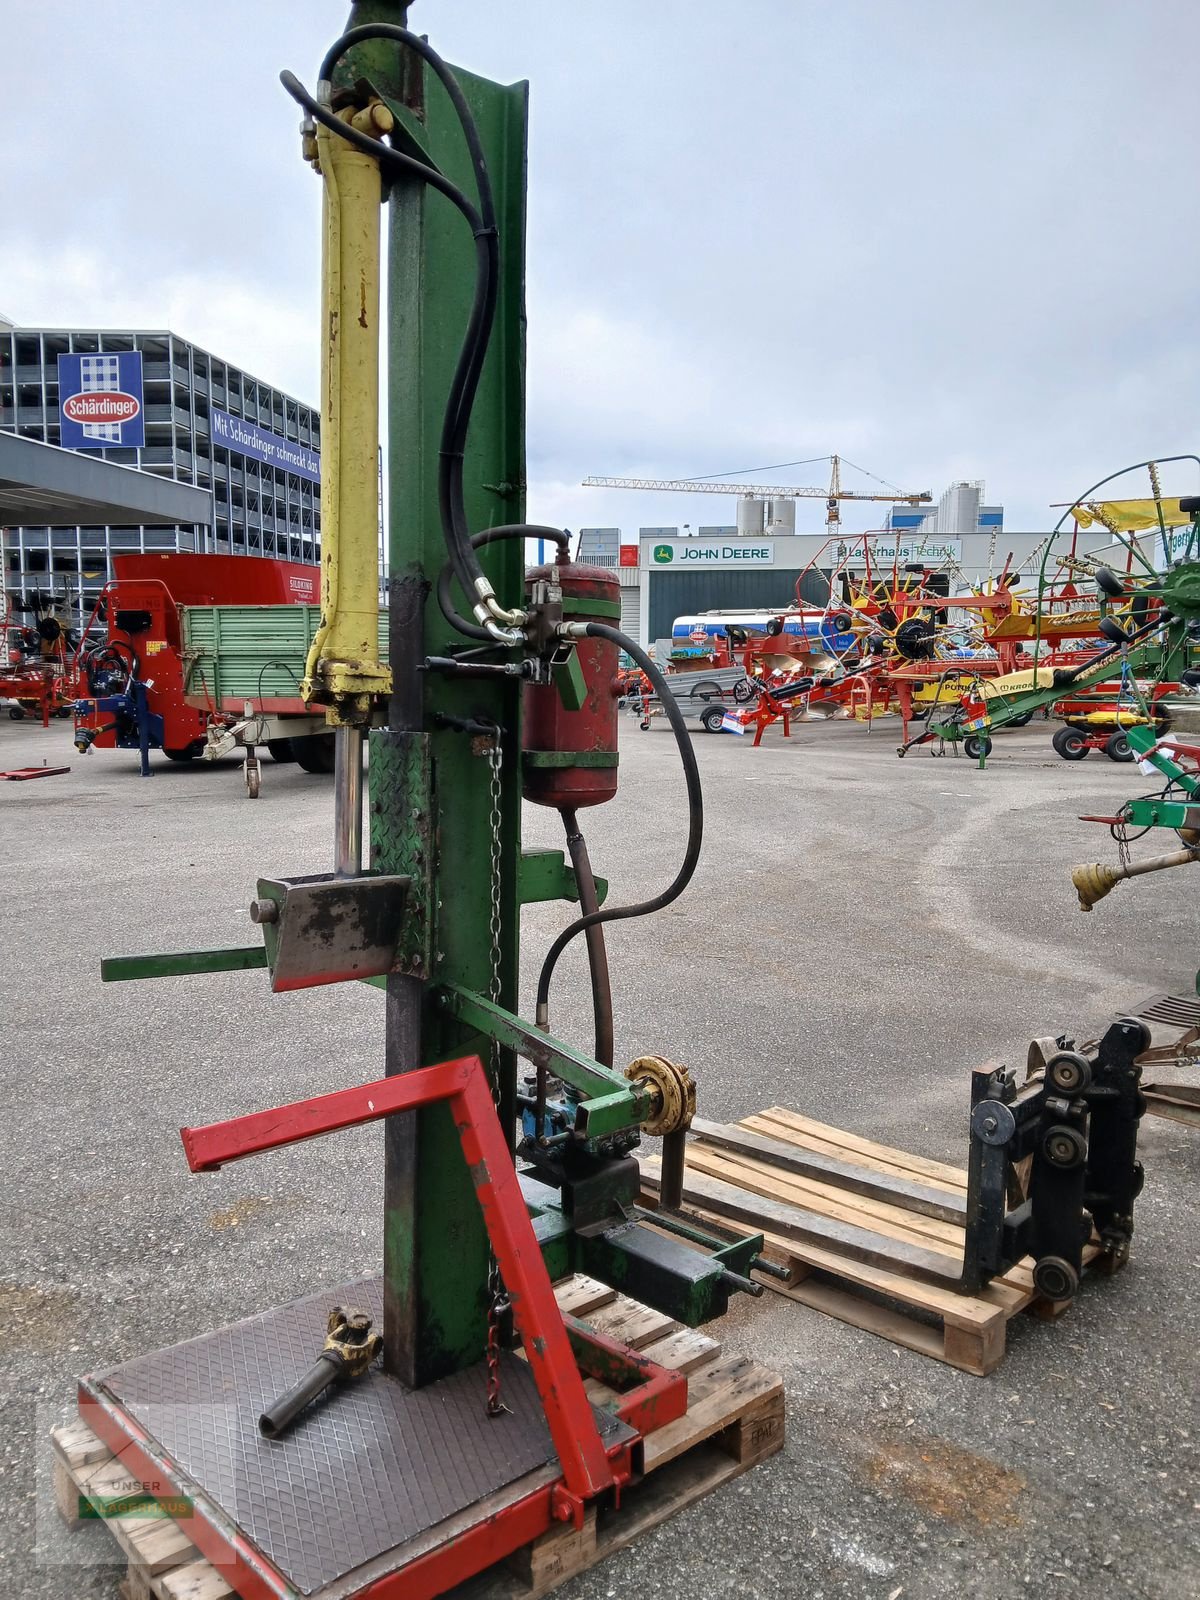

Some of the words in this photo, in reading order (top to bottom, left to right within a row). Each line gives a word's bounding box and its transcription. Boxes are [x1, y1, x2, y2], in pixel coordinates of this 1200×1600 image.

[69, 398, 135, 416] Schärdinger
[214, 413, 228, 438] Mit
[229, 420, 277, 461] Schärdinger
[276, 441, 307, 470] schmeckt
[307, 454, 318, 474] das
[680, 547, 718, 560] JOHN
[722, 547, 769, 559] DEERE
